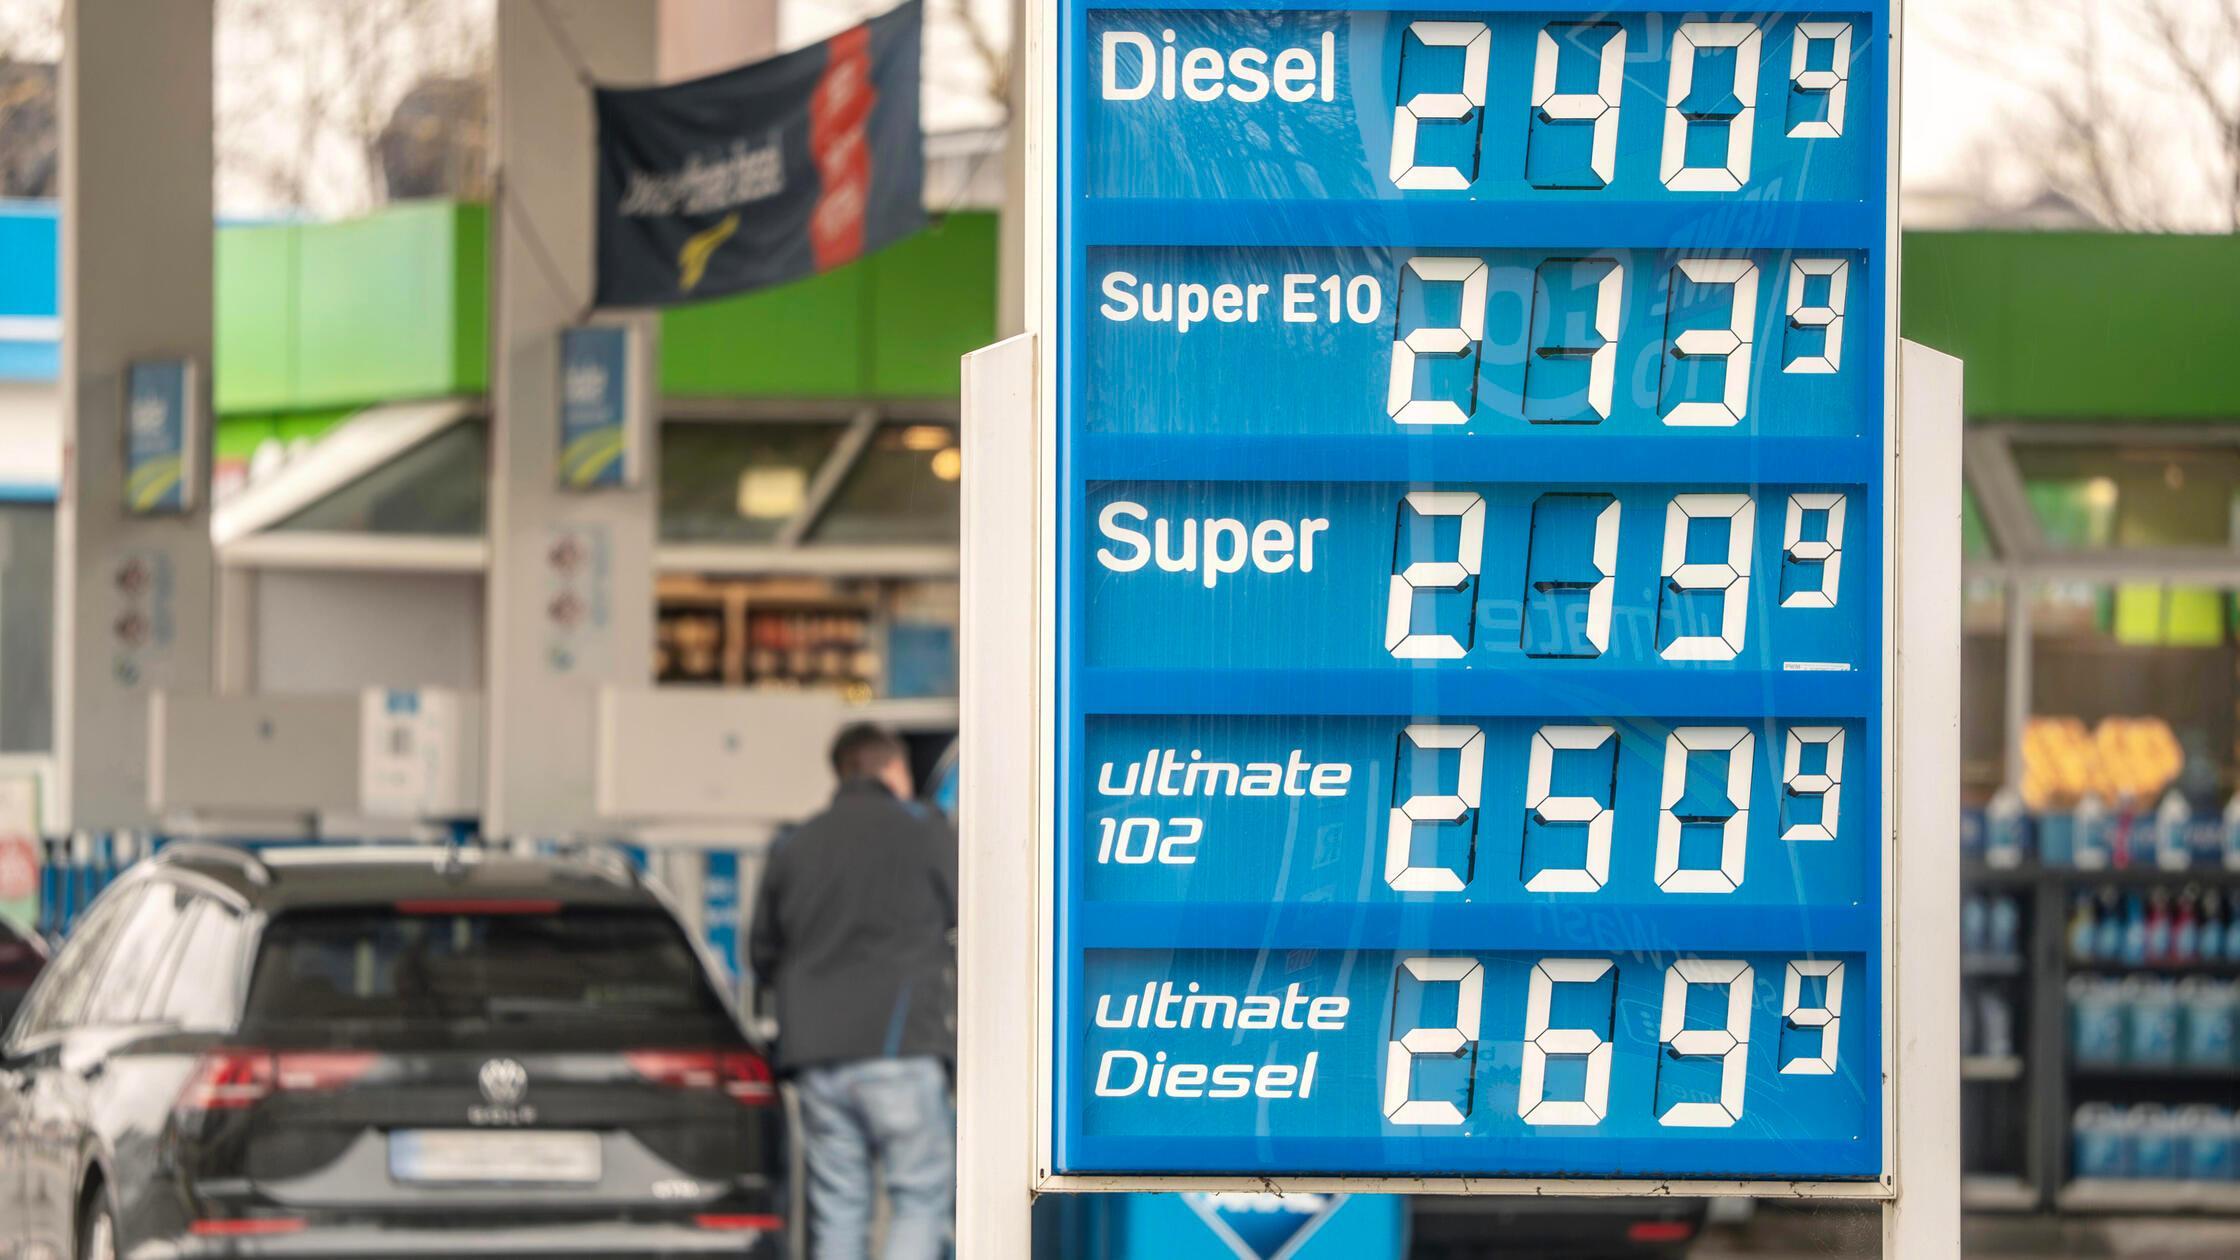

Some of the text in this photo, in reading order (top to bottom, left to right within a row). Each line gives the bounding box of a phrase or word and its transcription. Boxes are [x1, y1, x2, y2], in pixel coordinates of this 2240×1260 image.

[1102, 28, 1335, 103] Diesel
[1388, 21, 1852, 192] 240 9
[1100, 271, 1382, 333] Super E10
[1386, 259, 1850, 427] 213 9
[1097, 501, 1330, 589] Super
[1384, 492, 1846, 661] 219 9
[1098, 749, 1352, 797] ultimate
[1384, 725, 1846, 894] 250 9
[1098, 817, 1204, 866] 102
[1095, 982, 1350, 1030] ultimate
[1383, 960, 1845, 1128] 269 9
[1094, 1050, 1319, 1099] Diesel
